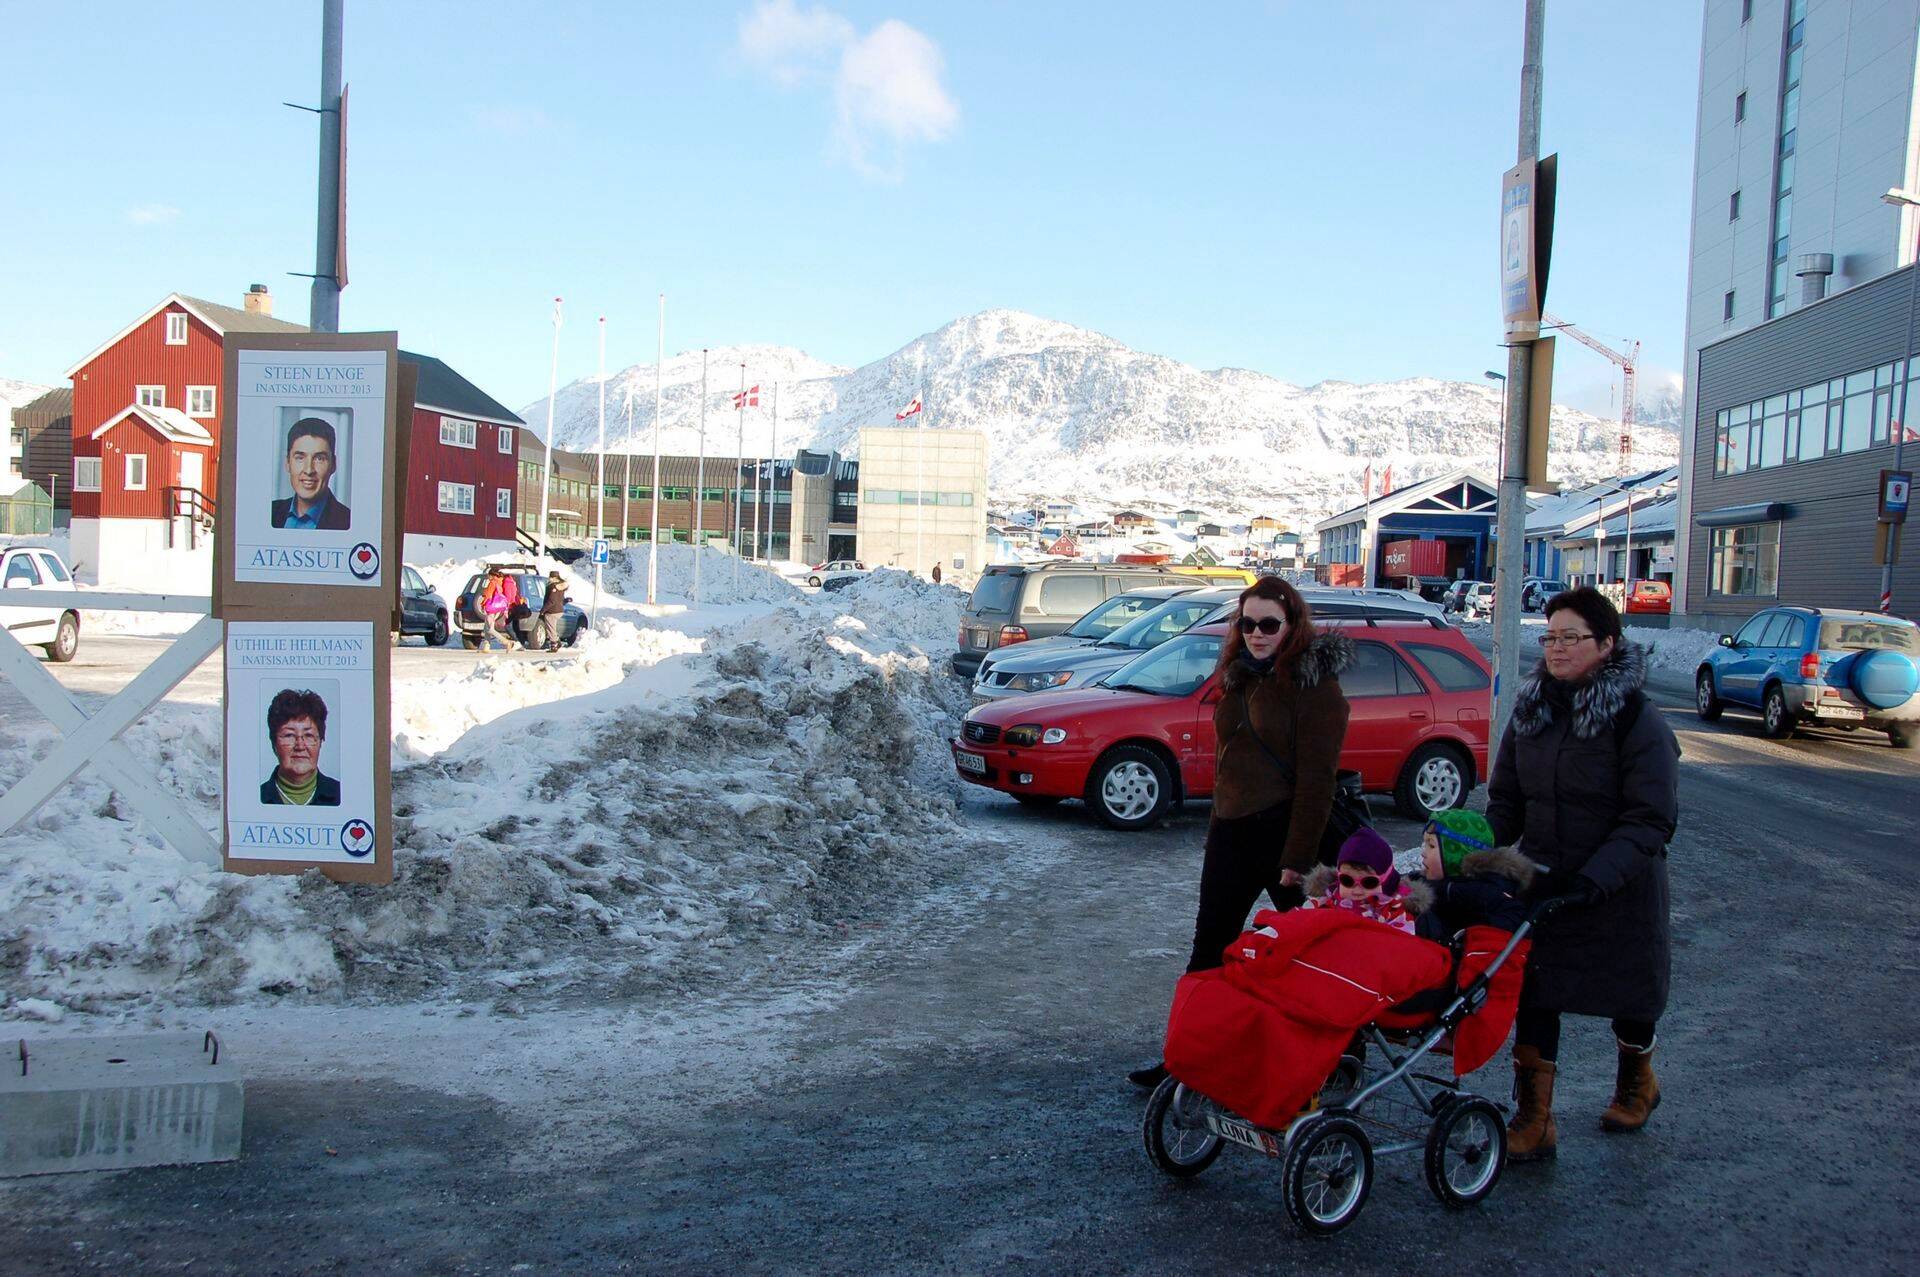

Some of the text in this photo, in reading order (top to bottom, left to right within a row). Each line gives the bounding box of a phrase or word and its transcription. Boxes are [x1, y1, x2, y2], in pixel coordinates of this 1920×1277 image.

[264, 366, 365, 380] STEEN LYNGE
[255, 383, 371, 395] INATSISARTUNUT 2013
[594, 541, 607, 561] P
[251, 549, 344, 569] ATASSUT
[234, 639, 363, 651] UTHILIE HEILMANN
[242, 655, 358, 666] INATSISARTUNUT 2013
[242, 825, 336, 846] ATASSUT
